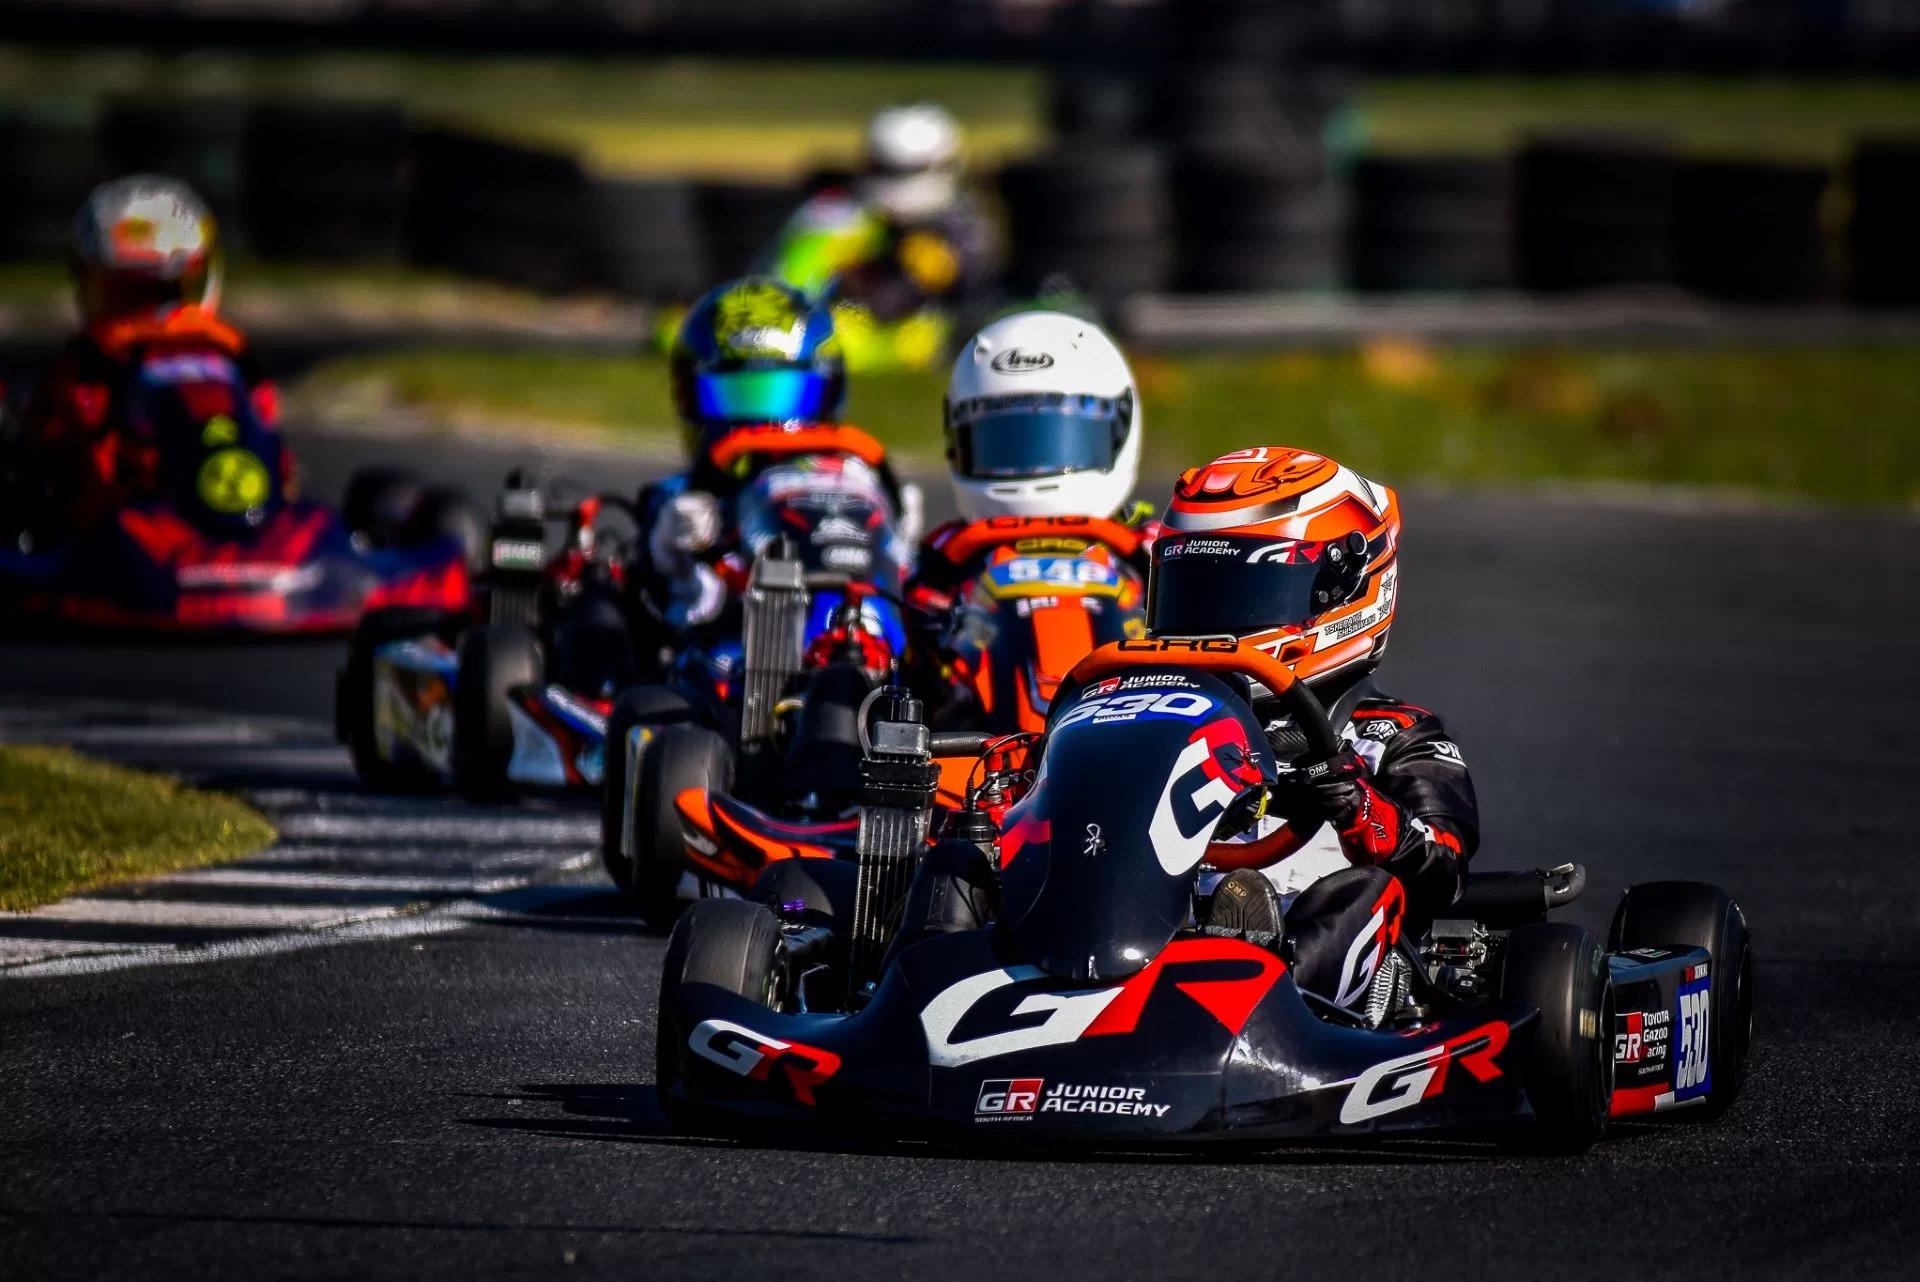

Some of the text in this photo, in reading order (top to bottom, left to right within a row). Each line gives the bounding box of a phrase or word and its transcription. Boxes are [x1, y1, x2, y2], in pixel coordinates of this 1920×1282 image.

[1164, 545, 1183, 556] GR
[1184, 547, 1241, 556] ACADEMY
[1117, 640, 1239, 652] CRG
[1082, 675, 1186, 700] GR JUNIOR
[1119, 681, 1201, 690] ACADEMY
[1049, 692, 1213, 737] 530
[1366, 720, 1395, 740] OMP
[1309, 764, 1328, 776] OMP
[1228, 881, 1247, 898] OMP
[920, 937, 1288, 1068] GR
[1643, 1009, 1670, 1027] TOYOTA
[1643, 1026, 1668, 1043] GAZOO
[1677, 989, 1710, 1089] 530
[1616, 1033, 1641, 1059] GR
[689, 1019, 843, 1106] GR
[1339, 1020, 1510, 1124] GR
[978, 1083, 1146, 1111] GR JUNIOR
[1040, 1098, 1171, 1117] ACADEMY
